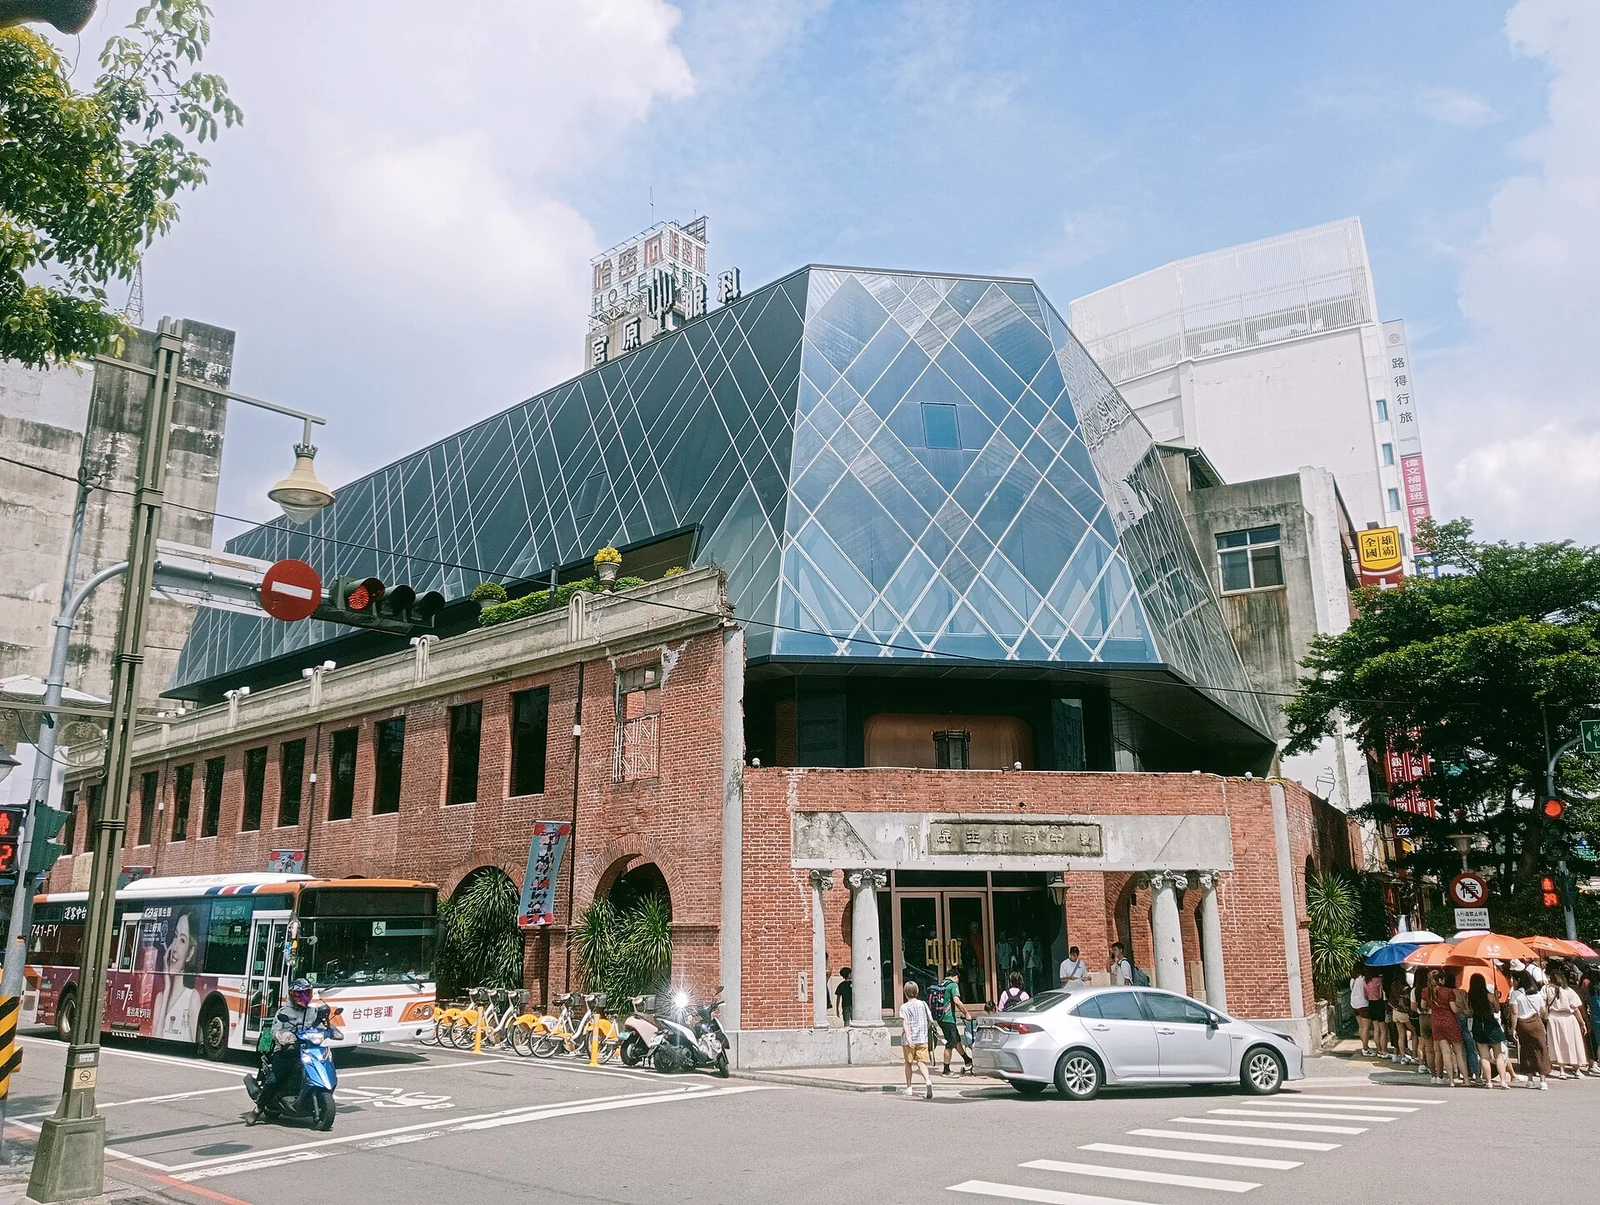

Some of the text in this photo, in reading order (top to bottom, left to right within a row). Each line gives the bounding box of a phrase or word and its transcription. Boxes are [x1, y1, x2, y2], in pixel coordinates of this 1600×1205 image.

[594, 272, 649, 311] HOTE
[1391, 357, 1413, 424] 路得行旅
[31, 923, 59, 937] 741-FY
[352, 1005, 394, 1020] 台中客運
